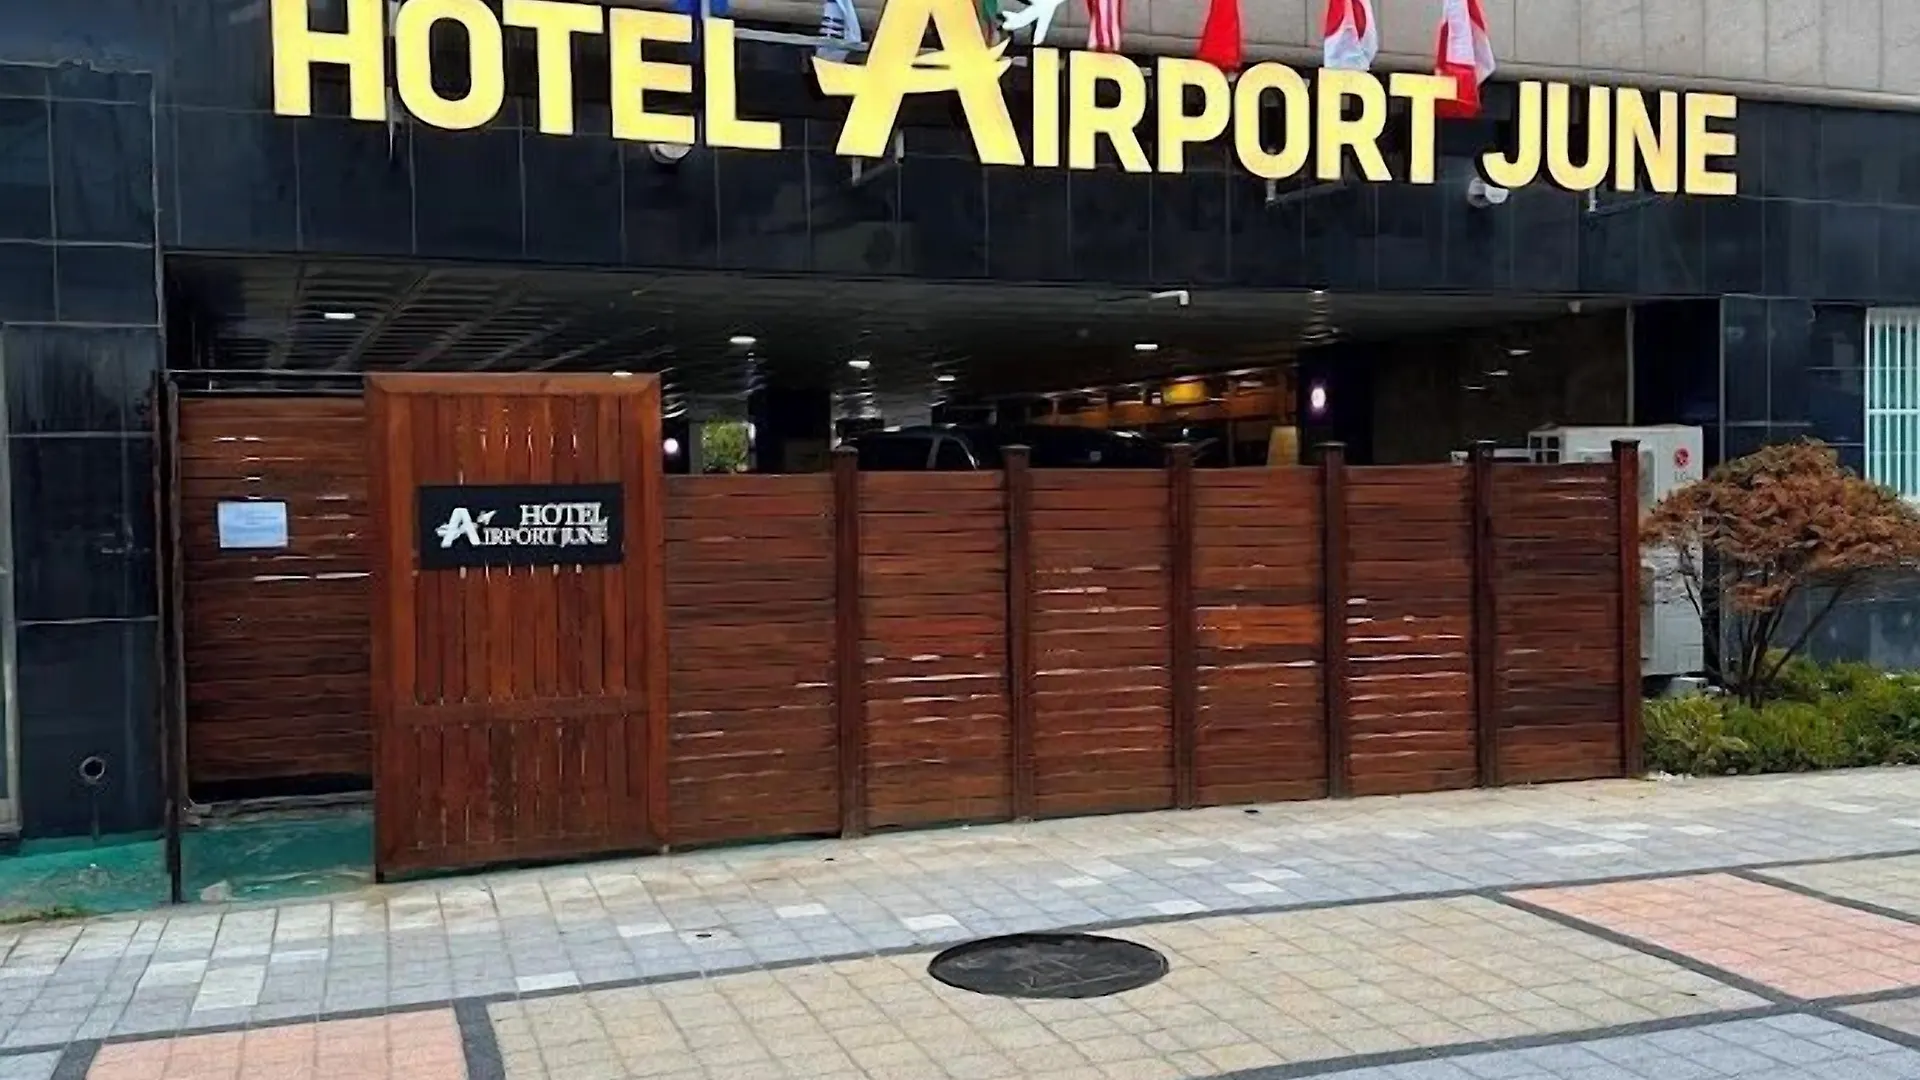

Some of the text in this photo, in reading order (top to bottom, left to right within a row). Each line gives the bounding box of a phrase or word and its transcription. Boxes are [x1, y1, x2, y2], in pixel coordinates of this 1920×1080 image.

[272, 0, 1738, 196] HOTEL AIRPORT JUNE
[435, 507, 608, 548] AIRPORT JUNE
[520, 503, 606, 525] HOTEL
